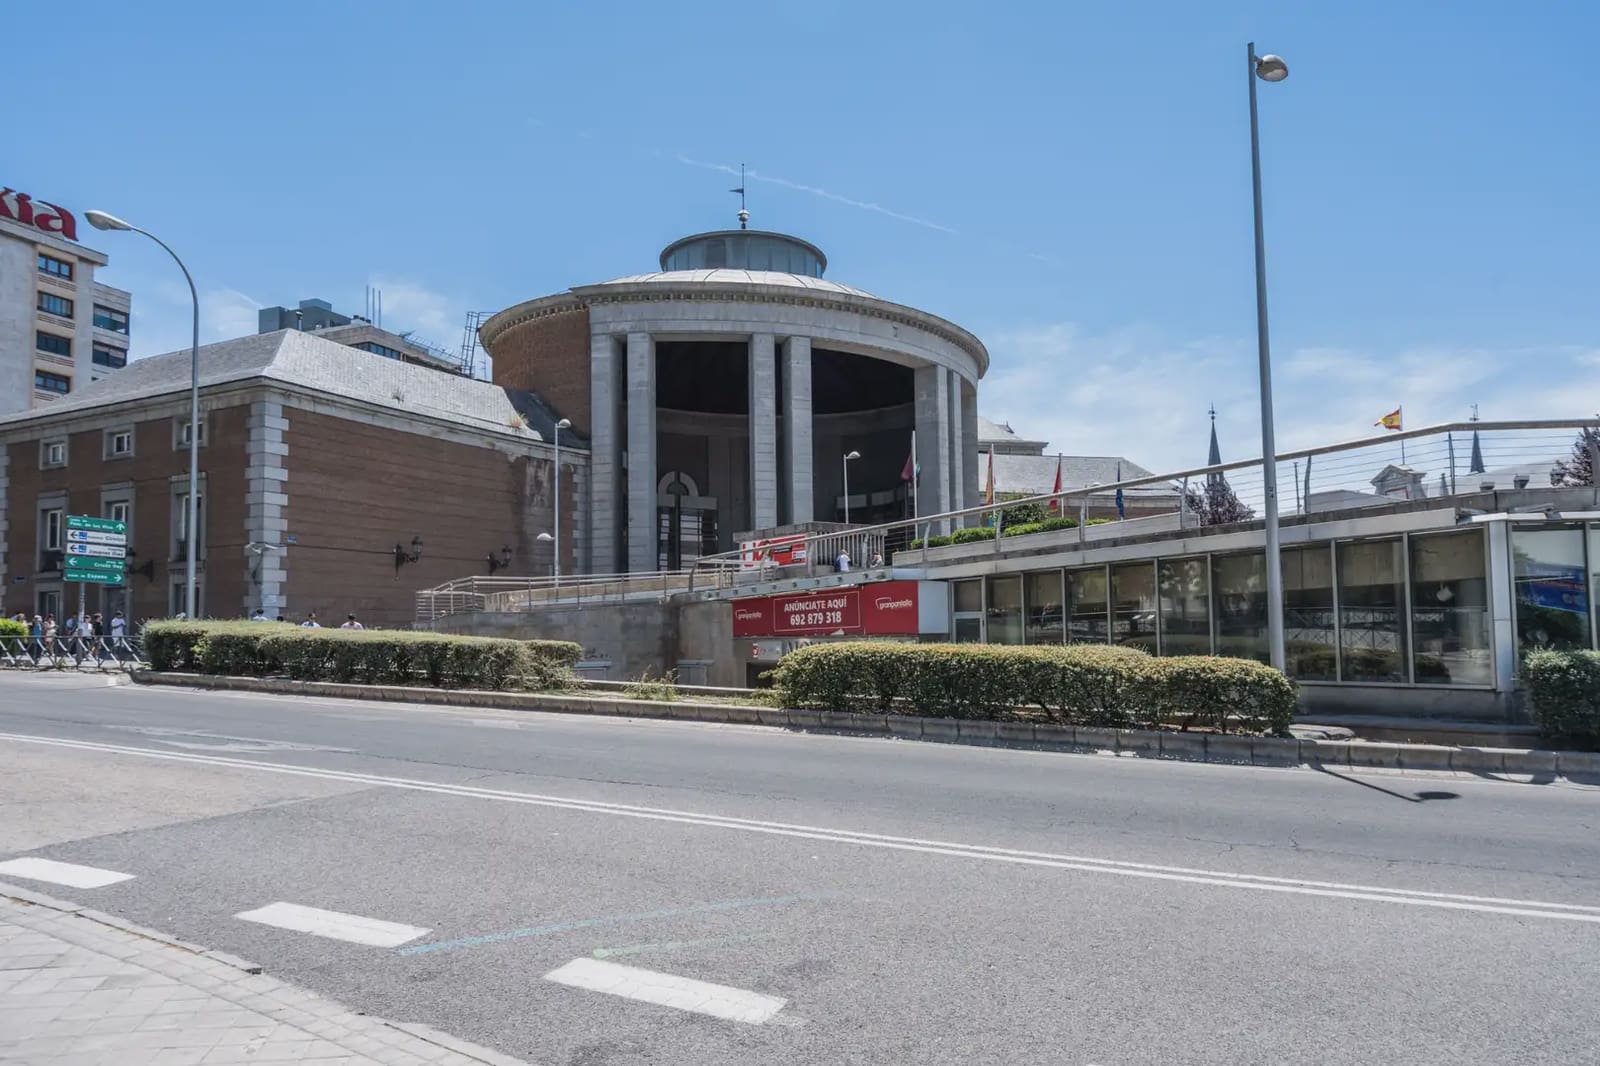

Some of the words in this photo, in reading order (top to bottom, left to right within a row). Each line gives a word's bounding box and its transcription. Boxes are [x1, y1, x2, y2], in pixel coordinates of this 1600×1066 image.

[784, 600, 826, 612] ANÚNCIATE
[827, 596, 847, 608] AQUÍ
[790, 614, 806, 626] 692
[808, 612, 824, 624] 879
[826, 611, 842, 624] 318
